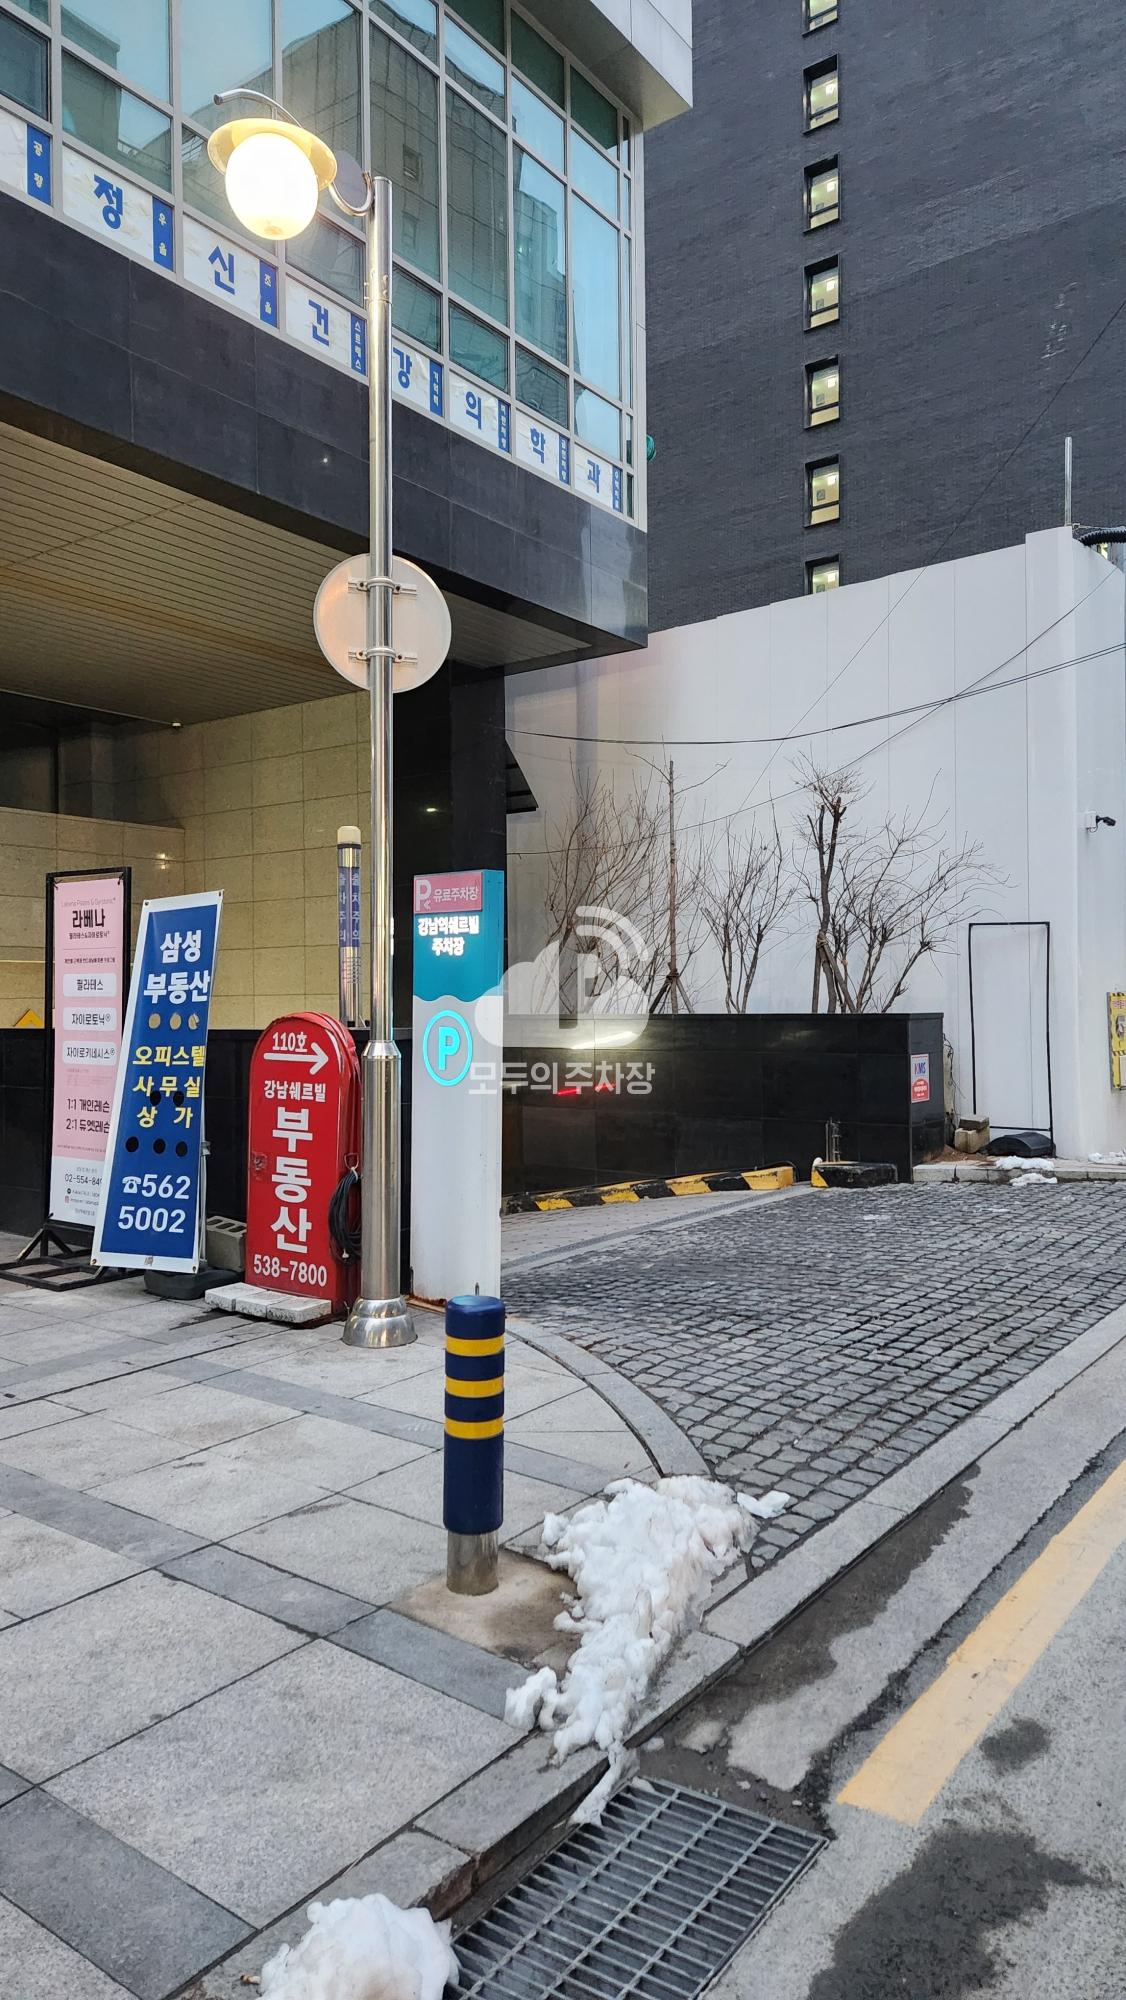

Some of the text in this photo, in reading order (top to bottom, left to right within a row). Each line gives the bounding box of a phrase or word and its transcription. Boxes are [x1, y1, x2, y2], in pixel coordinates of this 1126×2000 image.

[415, 879, 480, 911] P 유료주차장
[72, 907, 106, 929] 라베나
[159, 929, 202, 964] 삼성
[431, 936, 465, 957] 주차장
[76, 978, 104, 991] 필라테스
[143, 969, 211, 1005] 부동산
[271, 1031, 308, 1053] 110호
[438, 1026, 460, 1071] P
[132, 1045, 207, 1068] 오피스텔
[132, 1076, 201, 1098] 사무실
[263, 1079, 327, 1103] 강남쉐르빌
[67, 1098, 110, 1113] 1:1 개인레슨
[66, 1118, 77, 1130] 2:1
[141, 1173, 192, 1200] 562
[270, 1106, 314, 1254] 부동산
[117, 1205, 187, 1234] 5002
[252, 1253, 328, 1288] 538-7800
